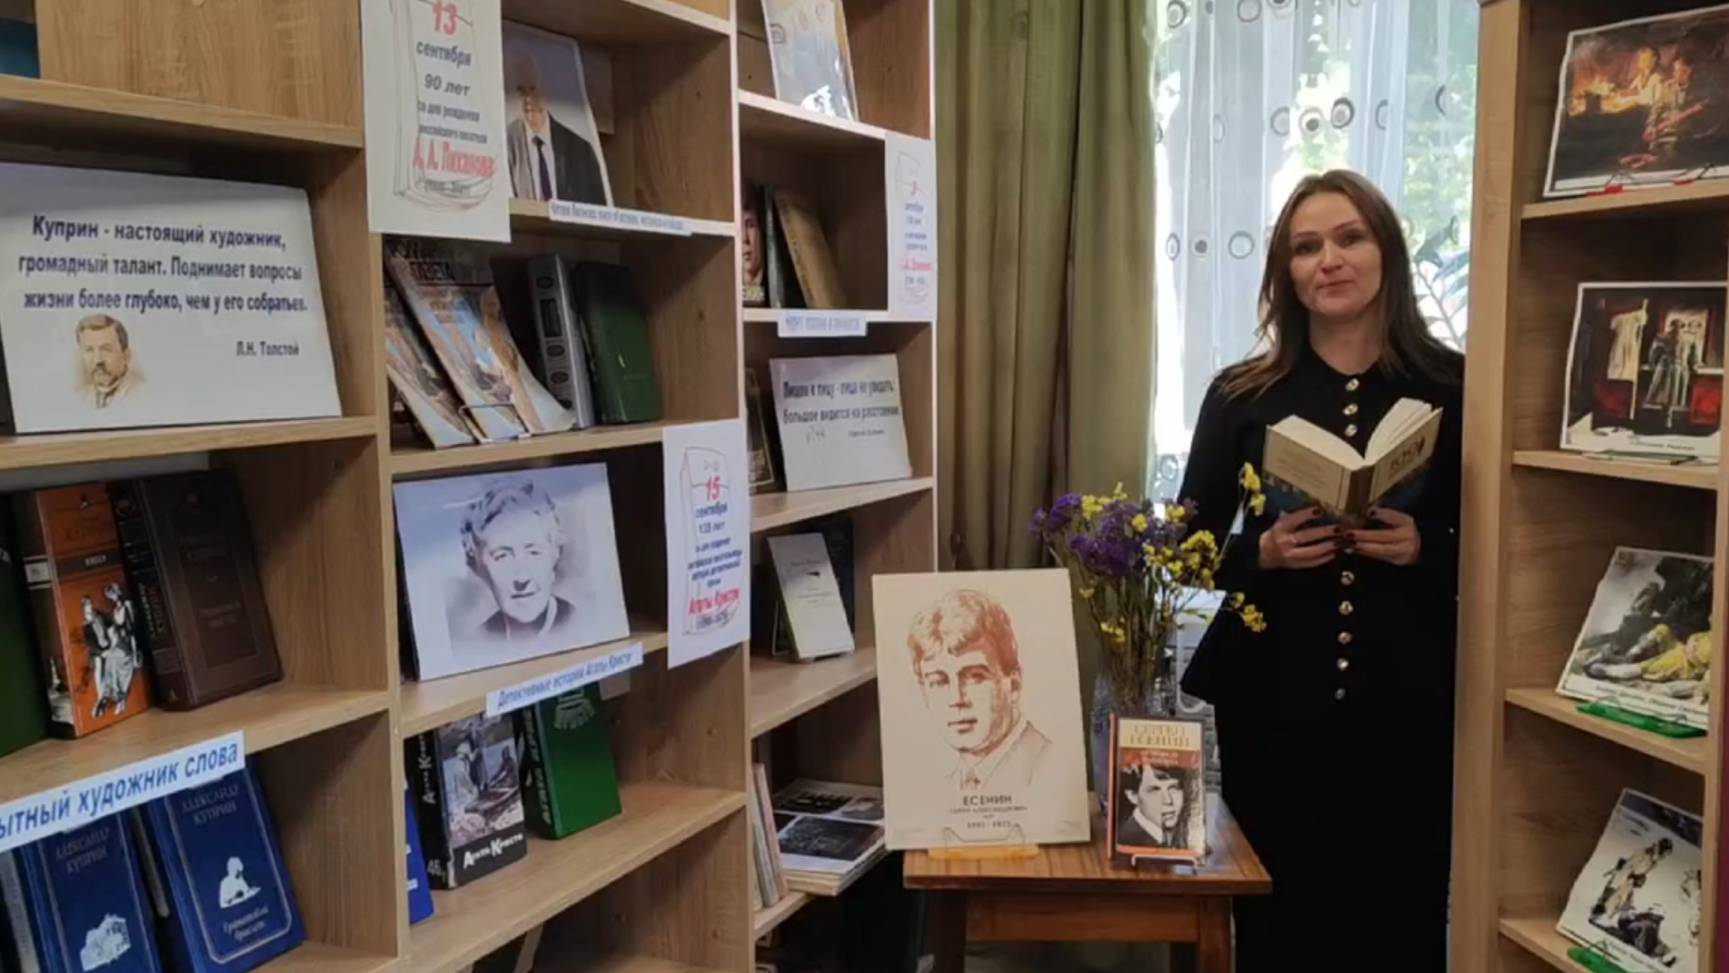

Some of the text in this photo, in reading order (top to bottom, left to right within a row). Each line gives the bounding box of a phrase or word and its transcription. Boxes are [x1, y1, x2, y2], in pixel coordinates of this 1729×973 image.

[432, 1, 459, 36] 13
[416, 41, 472, 68] сентября
[424, 73, 470, 97] 90 лет
[32, 214, 99, 242] Куприн
[114, 224, 205, 245] настоящий
[209, 227, 287, 250] художник,
[18, 253, 303, 285] громадный талант. Поднимает вопросы
[24, 291, 74, 309] жизни
[78, 288, 121, 310] более
[125, 289, 182, 314] глубоко,
[186, 294, 211, 310] чем
[213, 297, 221, 315] у
[224, 295, 244, 311] его
[236, 341, 300, 357] Л.Н. Толстой
[706, 476, 721, 501] 15
[77, 762, 180, 819] художник
[184, 742, 239, 778] слова
[963, 794, 1013, 806] ЕСЕНИН
